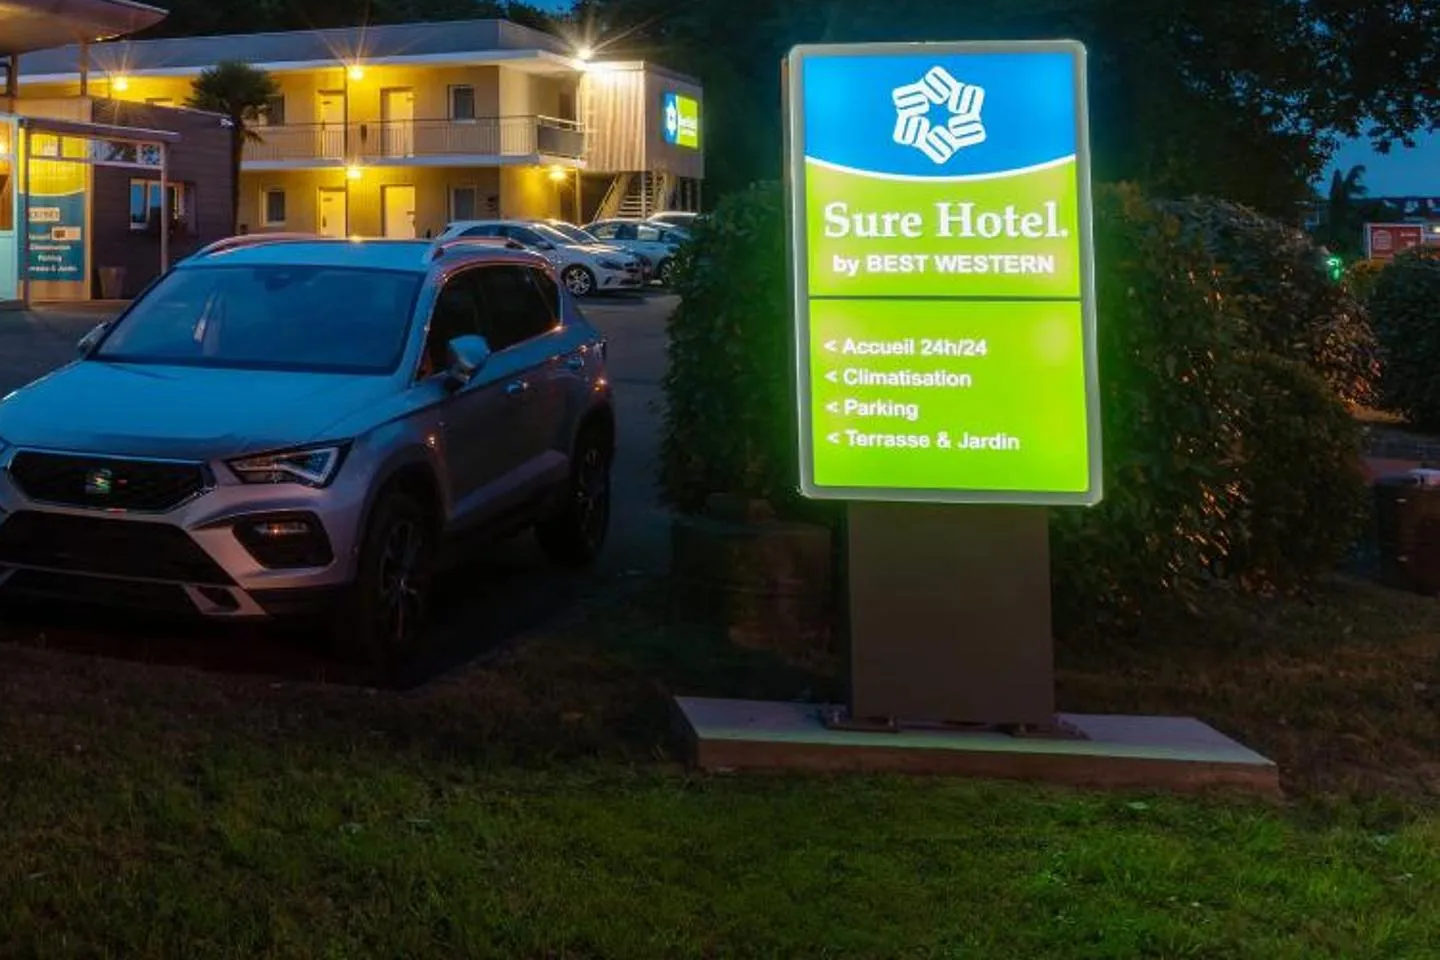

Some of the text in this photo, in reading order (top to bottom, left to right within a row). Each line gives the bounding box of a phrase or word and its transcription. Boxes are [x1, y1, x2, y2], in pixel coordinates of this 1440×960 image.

[823, 200, 1069, 238] Sure Hotel.
[832, 254, 1054, 277] by BEST WESTERN
[842, 338, 988, 356] Accueil 24h/24
[843, 368, 972, 387] Climatisation
[844, 398, 919, 421] Parking
[845, 429, 1020, 451] Terrasse & Jardin
